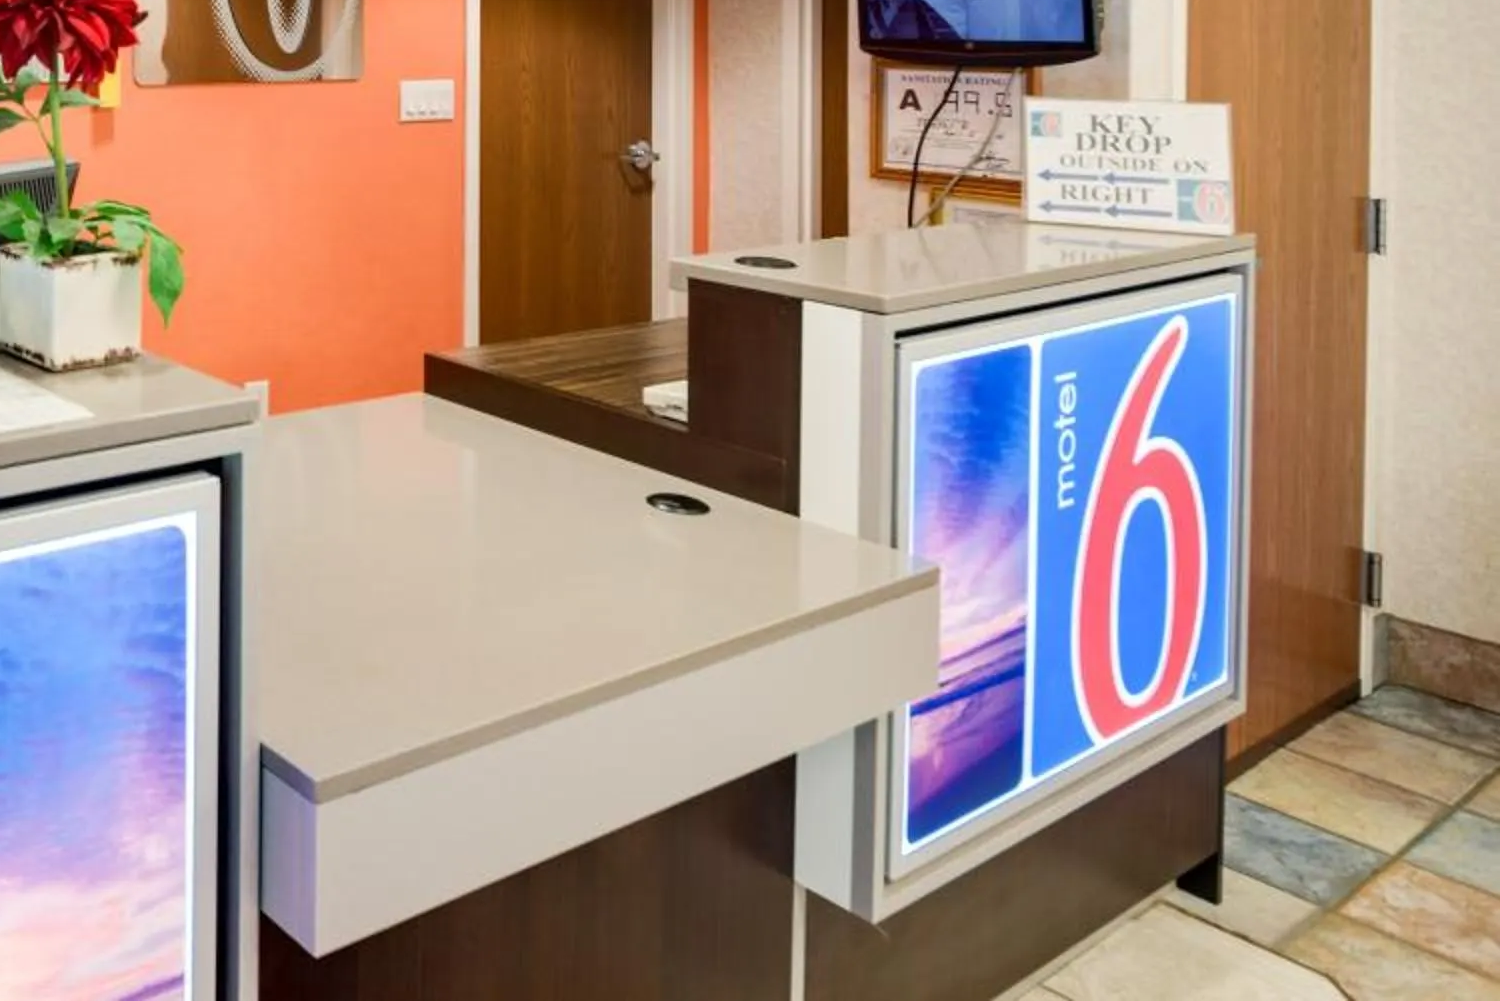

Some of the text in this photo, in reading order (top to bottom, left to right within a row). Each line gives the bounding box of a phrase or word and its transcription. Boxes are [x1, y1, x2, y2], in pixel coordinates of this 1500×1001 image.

[901, 74, 962, 84] SANITATIN
[899, 88, 922, 111] A
[1090, 114, 1162, 135] KEY
[1076, 131, 1172, 154] DROP
[1059, 154, 1210, 174] OUTSIDE ON
[1060, 184, 1154, 205] RIGHT
[1054, 371, 1077, 510] motel
[1070, 314, 1208, 745] 6
